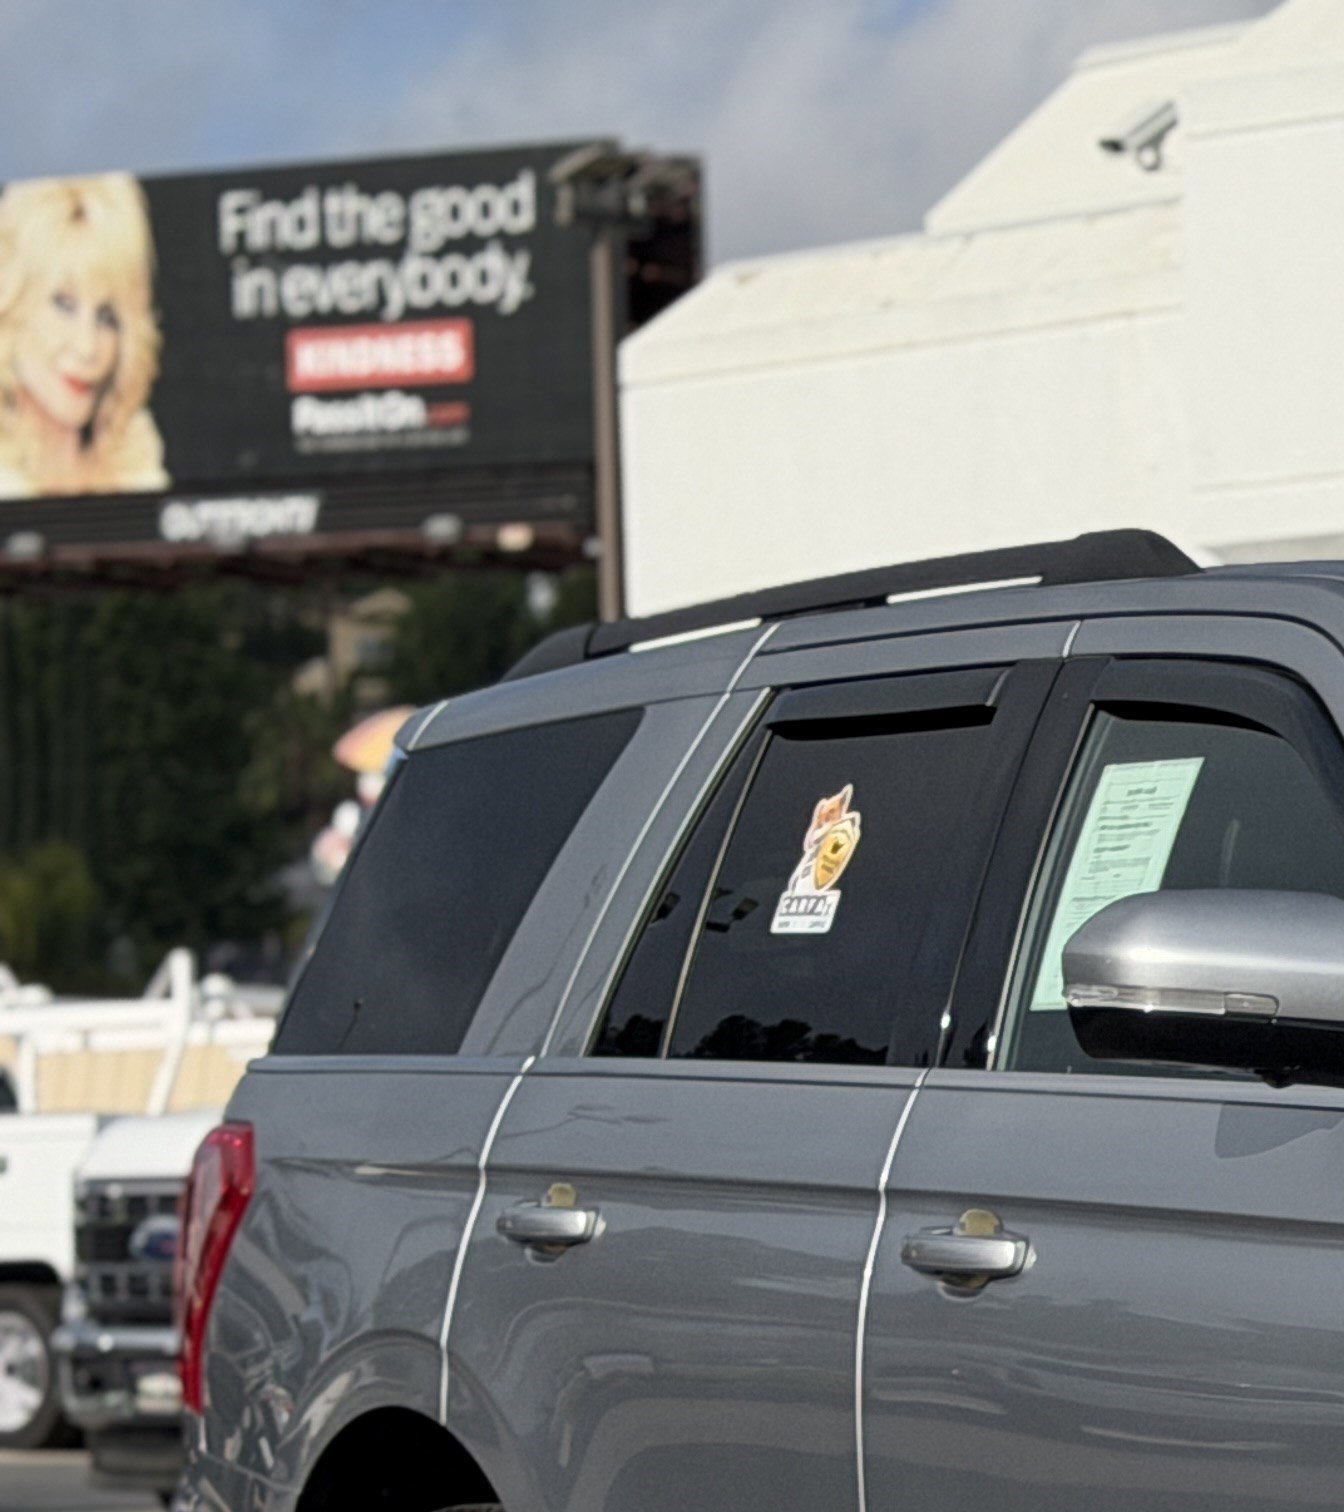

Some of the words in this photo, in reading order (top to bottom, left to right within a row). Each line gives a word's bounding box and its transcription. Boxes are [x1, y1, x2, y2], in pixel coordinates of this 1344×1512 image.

[219, 184, 320, 254] Find
[324, 182, 404, 249] the
[408, 168, 536, 252] good
[230, 253, 277, 319] in
